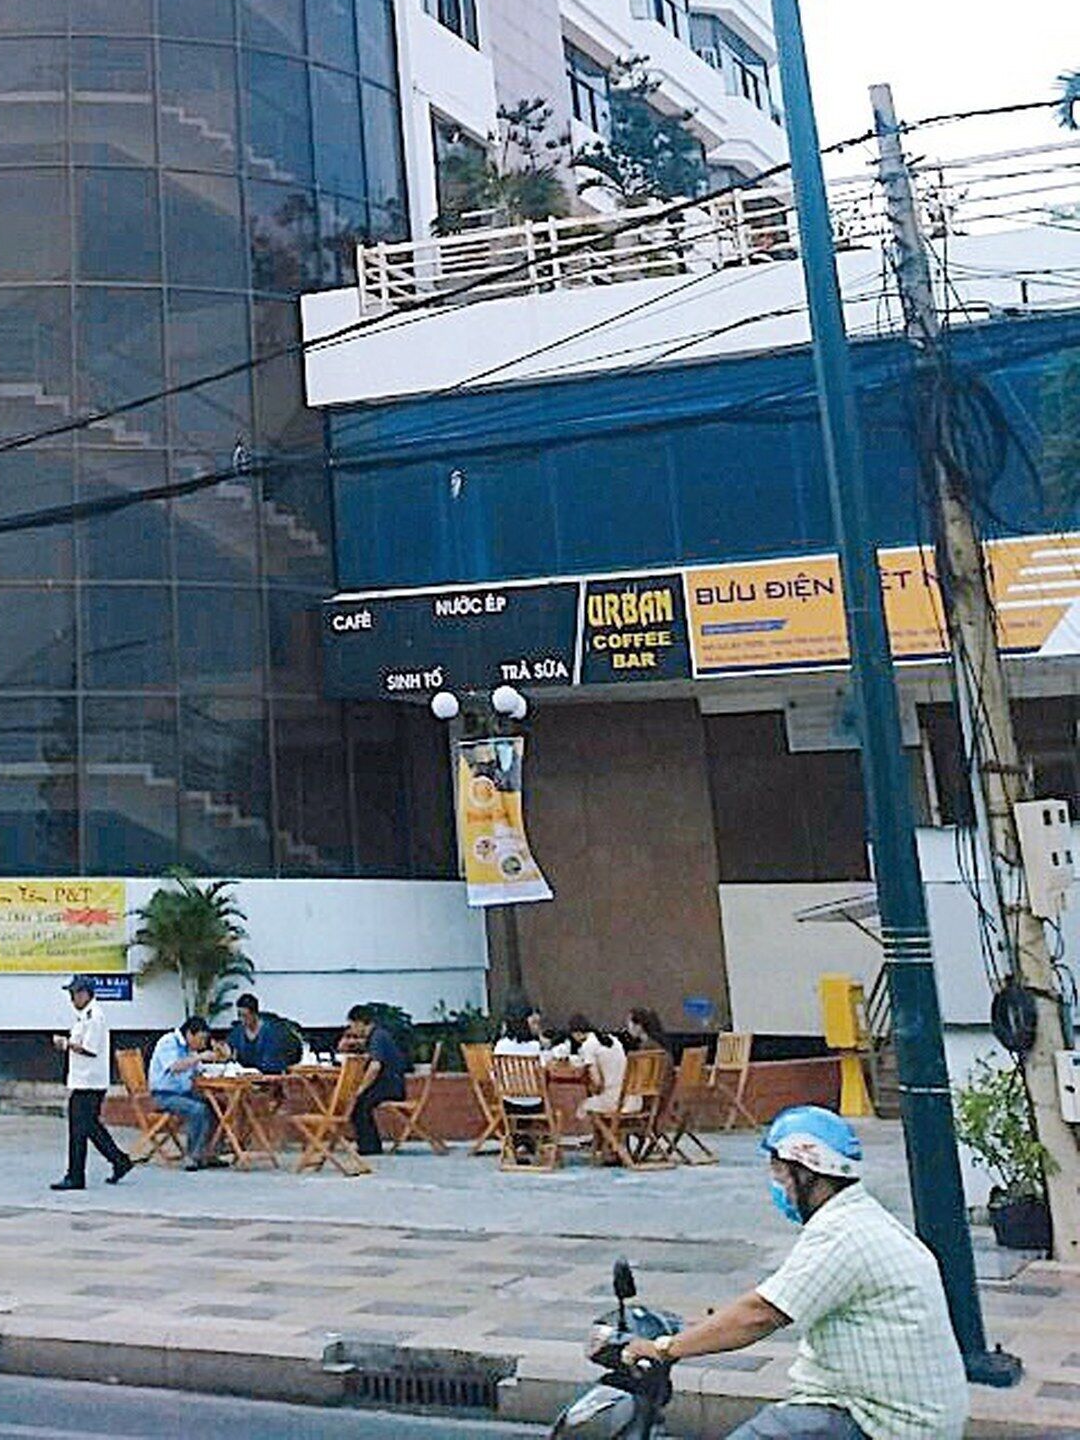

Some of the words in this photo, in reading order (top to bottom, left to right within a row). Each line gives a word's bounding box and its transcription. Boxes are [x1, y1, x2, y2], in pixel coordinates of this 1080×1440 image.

[696, 580, 756, 605] BƯU
[765, 572, 835, 603] ĐIỆN
[587, 588, 674, 627] URBAN
[592, 630, 673, 650] COFFEE
[613, 652, 657, 669] BAR
[387, 673, 421, 691] SINH
